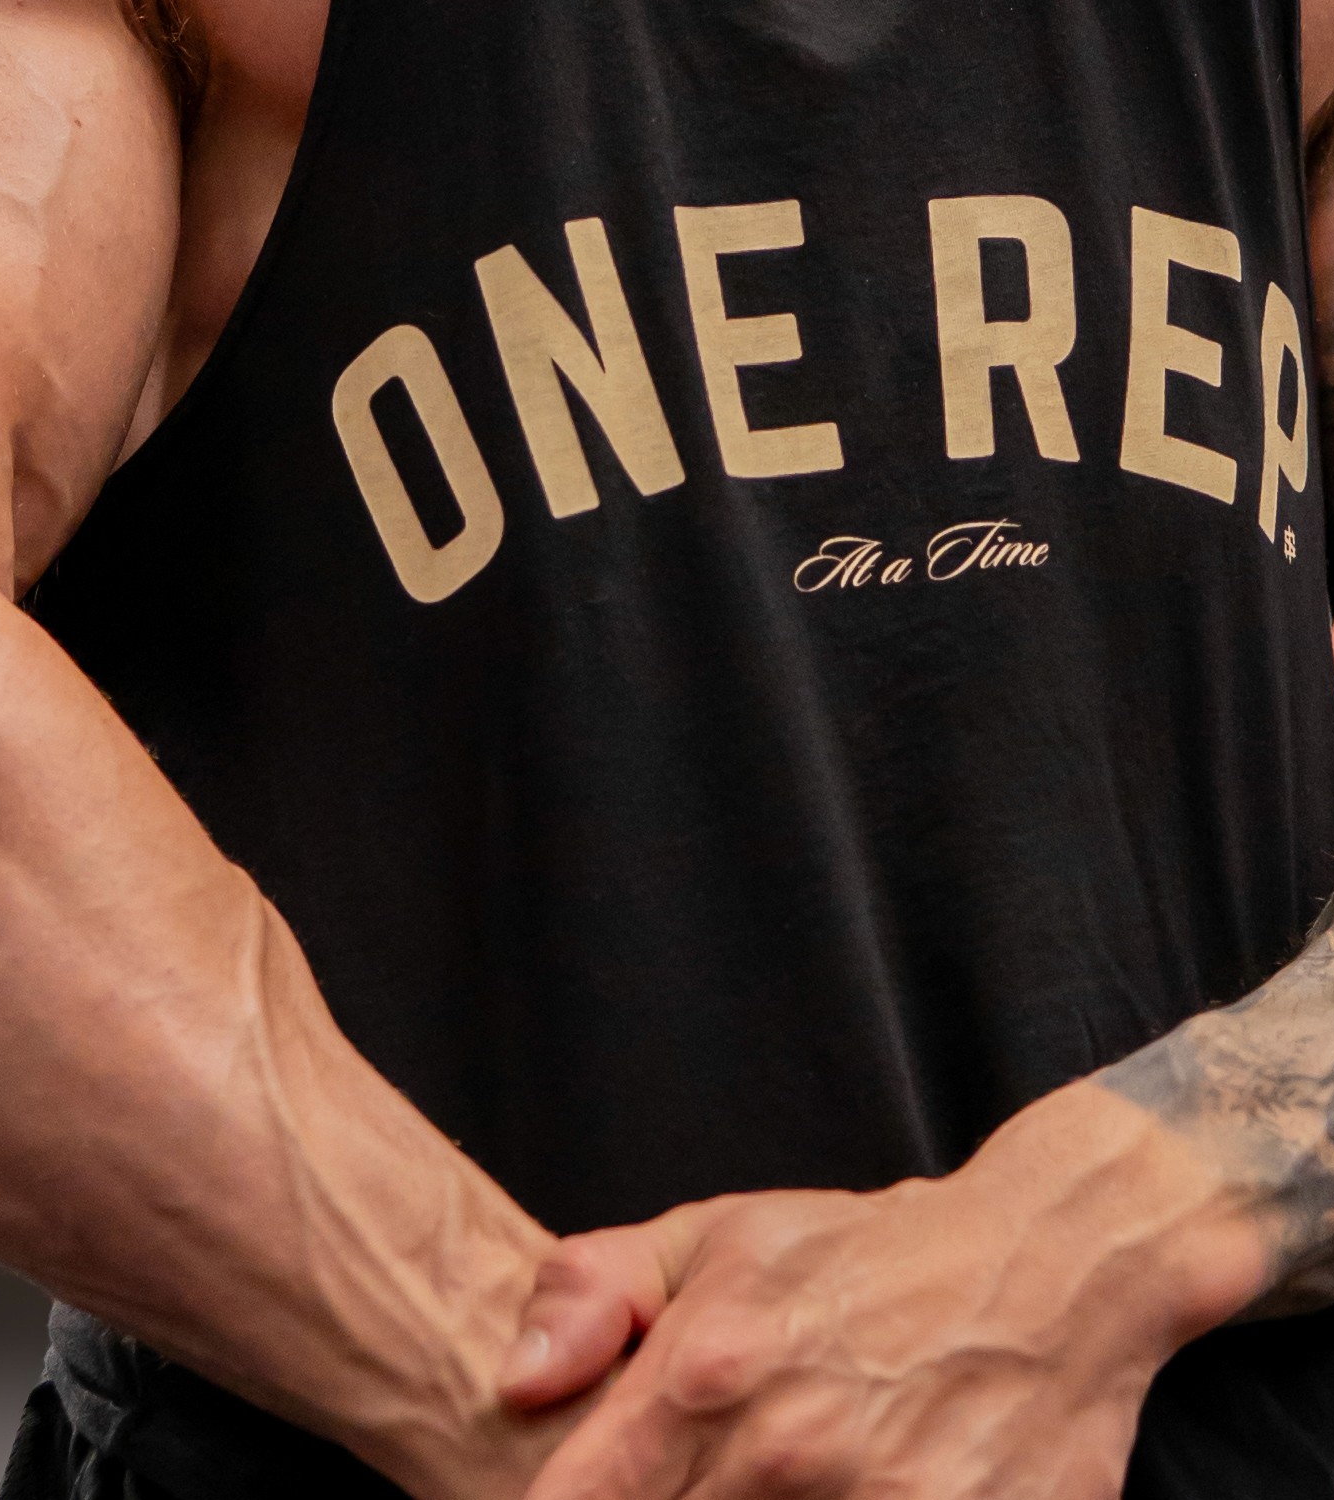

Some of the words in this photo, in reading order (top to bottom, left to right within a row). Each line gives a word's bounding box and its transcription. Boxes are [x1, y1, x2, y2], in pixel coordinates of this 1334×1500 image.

[332, 199, 844, 604] ONE
[928, 194, 1308, 544] REP
[794, 536, 883, 592] At
[880, 556, 913, 585] a
[927, 518, 1049, 581] Time
